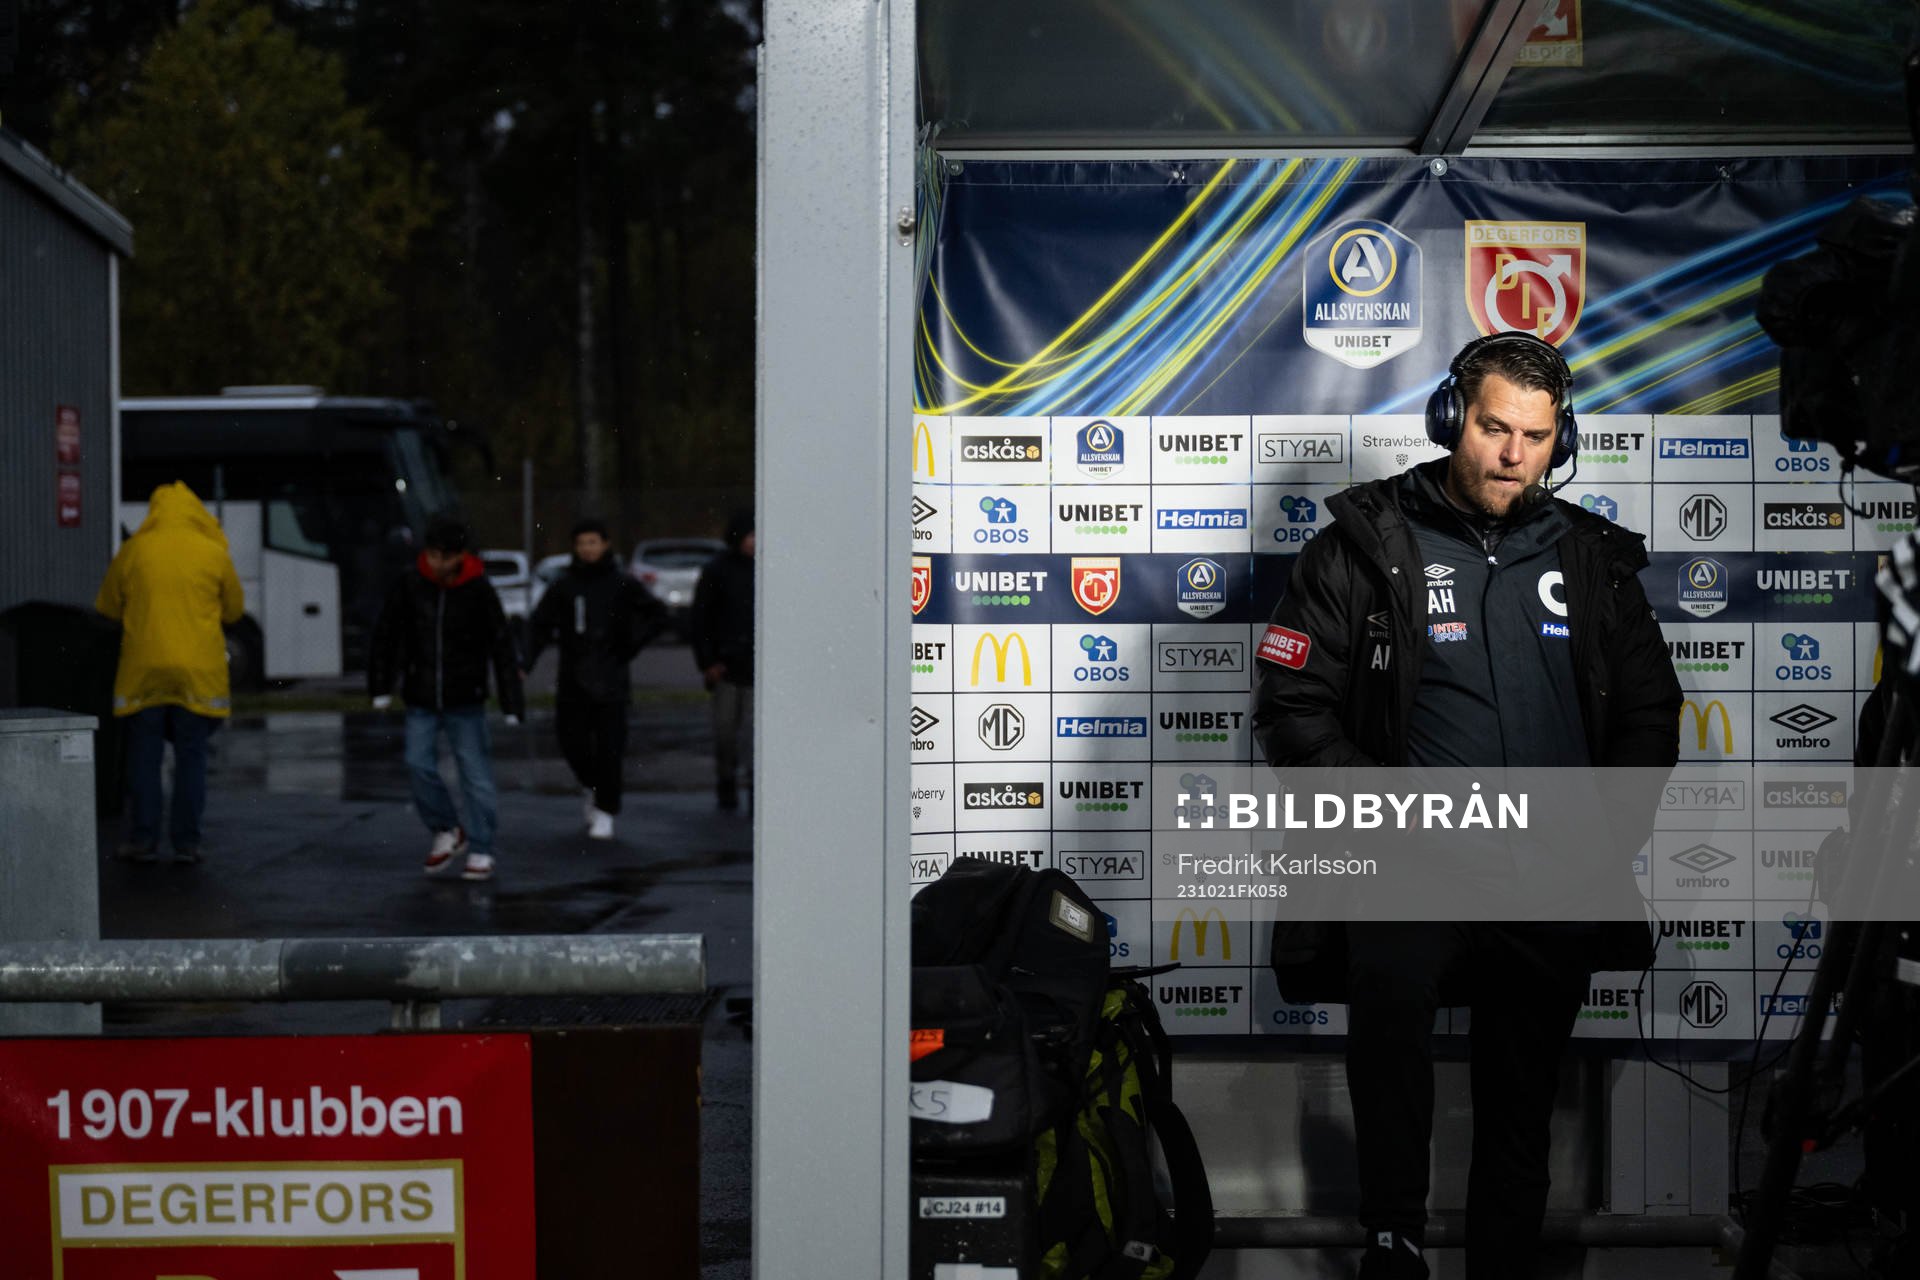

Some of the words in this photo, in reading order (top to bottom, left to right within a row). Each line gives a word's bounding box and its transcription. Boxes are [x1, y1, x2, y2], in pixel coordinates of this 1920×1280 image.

[1474, 228, 1577, 242] DEGERFORS
[1315, 303, 1410, 321] ALLSVENSKAN
[1334, 336, 1391, 348] UNIBET
[964, 438, 1026, 460] askås
[1159, 434, 1243, 451] UNIBET
[1662, 440, 1745, 457] Helmia
[1081, 453, 1120, 462] ALLSVENSKAN
[1775, 457, 1830, 472] OBOS
[1059, 504, 1143, 521] UNIBET
[1159, 510, 1244, 528] Helmia
[1683, 498, 1723, 537] MG
[1767, 506, 1828, 527] askås
[974, 529, 1029, 543] OBOS
[1274, 528, 1321, 542] OBO
[956, 571, 1047, 592] UNIBET
[1757, 570, 1850, 590] UNIBET
[1182, 591, 1222, 600] ALLSVENSKAN
[1428, 589, 1456, 614] AH
[1683, 591, 1723, 599] ALLSVENSKAN
[1263, 632, 1306, 655] UNIBET
[1074, 667, 1129, 682] OBOS
[1776, 666, 1832, 681] OBOS
[983, 708, 1020, 746] MG
[1059, 719, 1143, 735] Helmia
[1160, 712, 1243, 729] UNIBET
[1776, 736, 1830, 748] umbro
[966, 785, 1026, 807] askås
[1060, 782, 1143, 799] UNIBET
[1767, 784, 1830, 805] askås
[1676, 875, 1729, 888] umbro
[1661, 920, 1745, 938] UNIBET
[1160, 986, 1243, 1003] UNIBET
[1683, 985, 1723, 1024] MG
[1273, 1010, 1328, 1025] OBOS
[47, 1085, 463, 1139] 1907-klubben
[80, 1181, 434, 1226] DEGERFORS
[933, 1202, 971, 1215] CJ24
[975, 1202, 1001, 1214] #14
